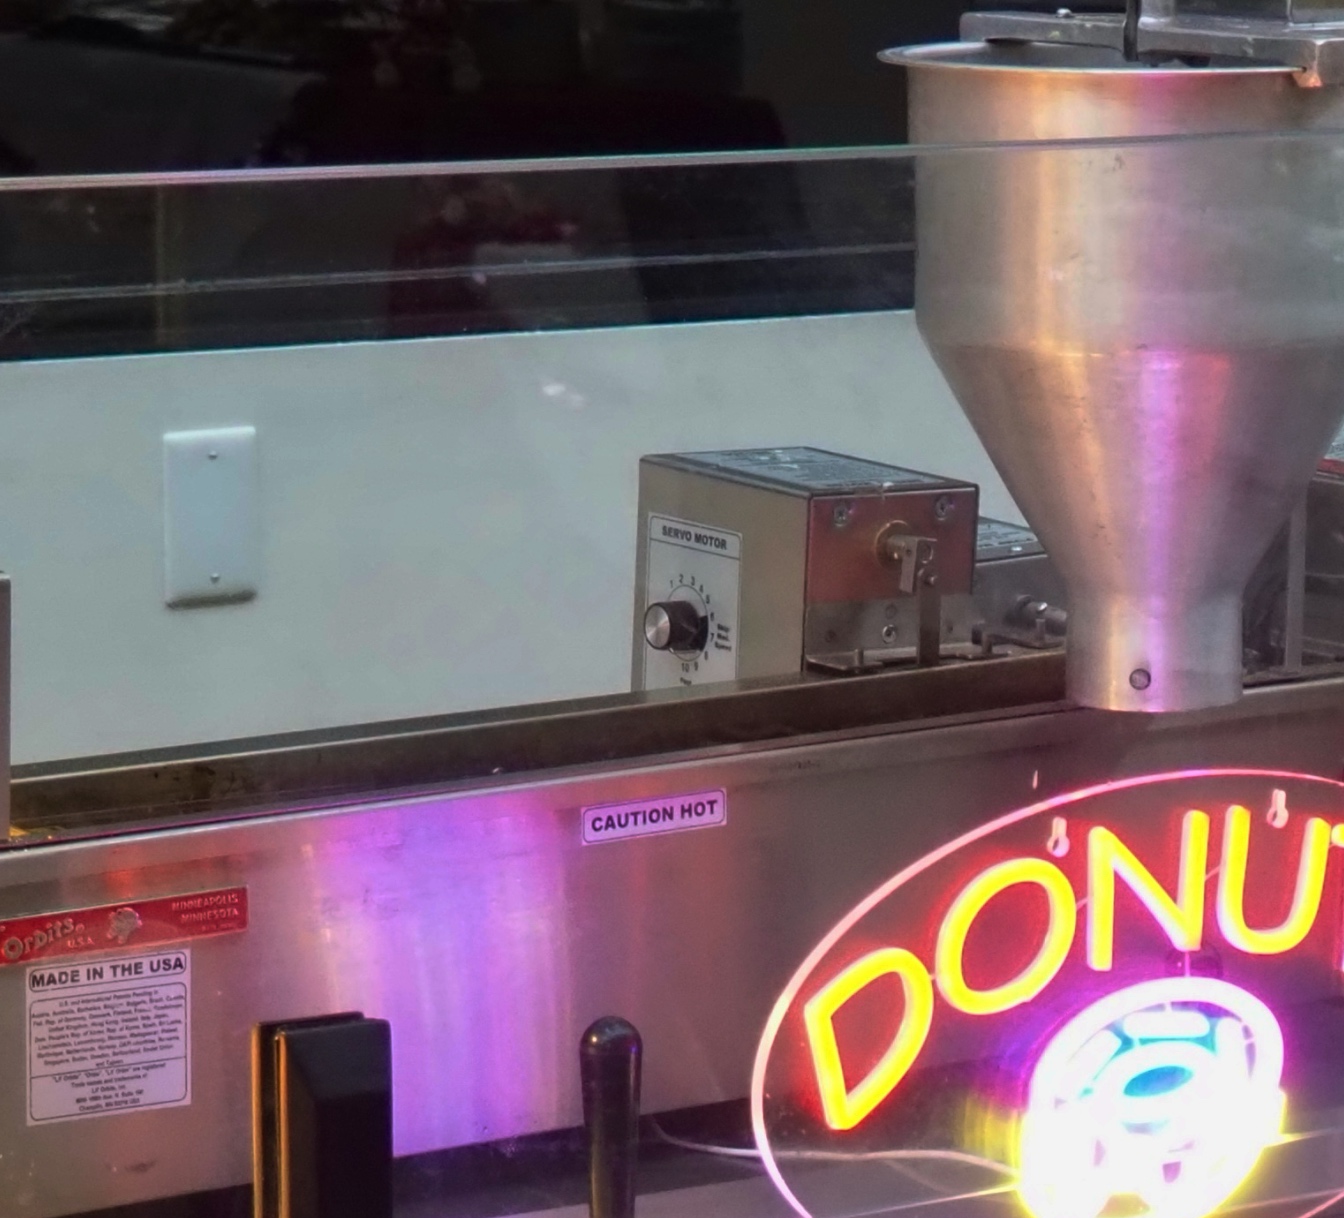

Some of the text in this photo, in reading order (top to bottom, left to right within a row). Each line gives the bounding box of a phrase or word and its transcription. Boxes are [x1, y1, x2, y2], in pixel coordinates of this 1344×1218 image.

[662, 525, 727, 550] SERVO MOTOR
[681, 662, 690, 673] 10
[591, 799, 718, 832] CAUTION HOT
[181, 908, 239, 923] MINNESOTA
[31, 957, 184, 988] MADE IN THE USA
